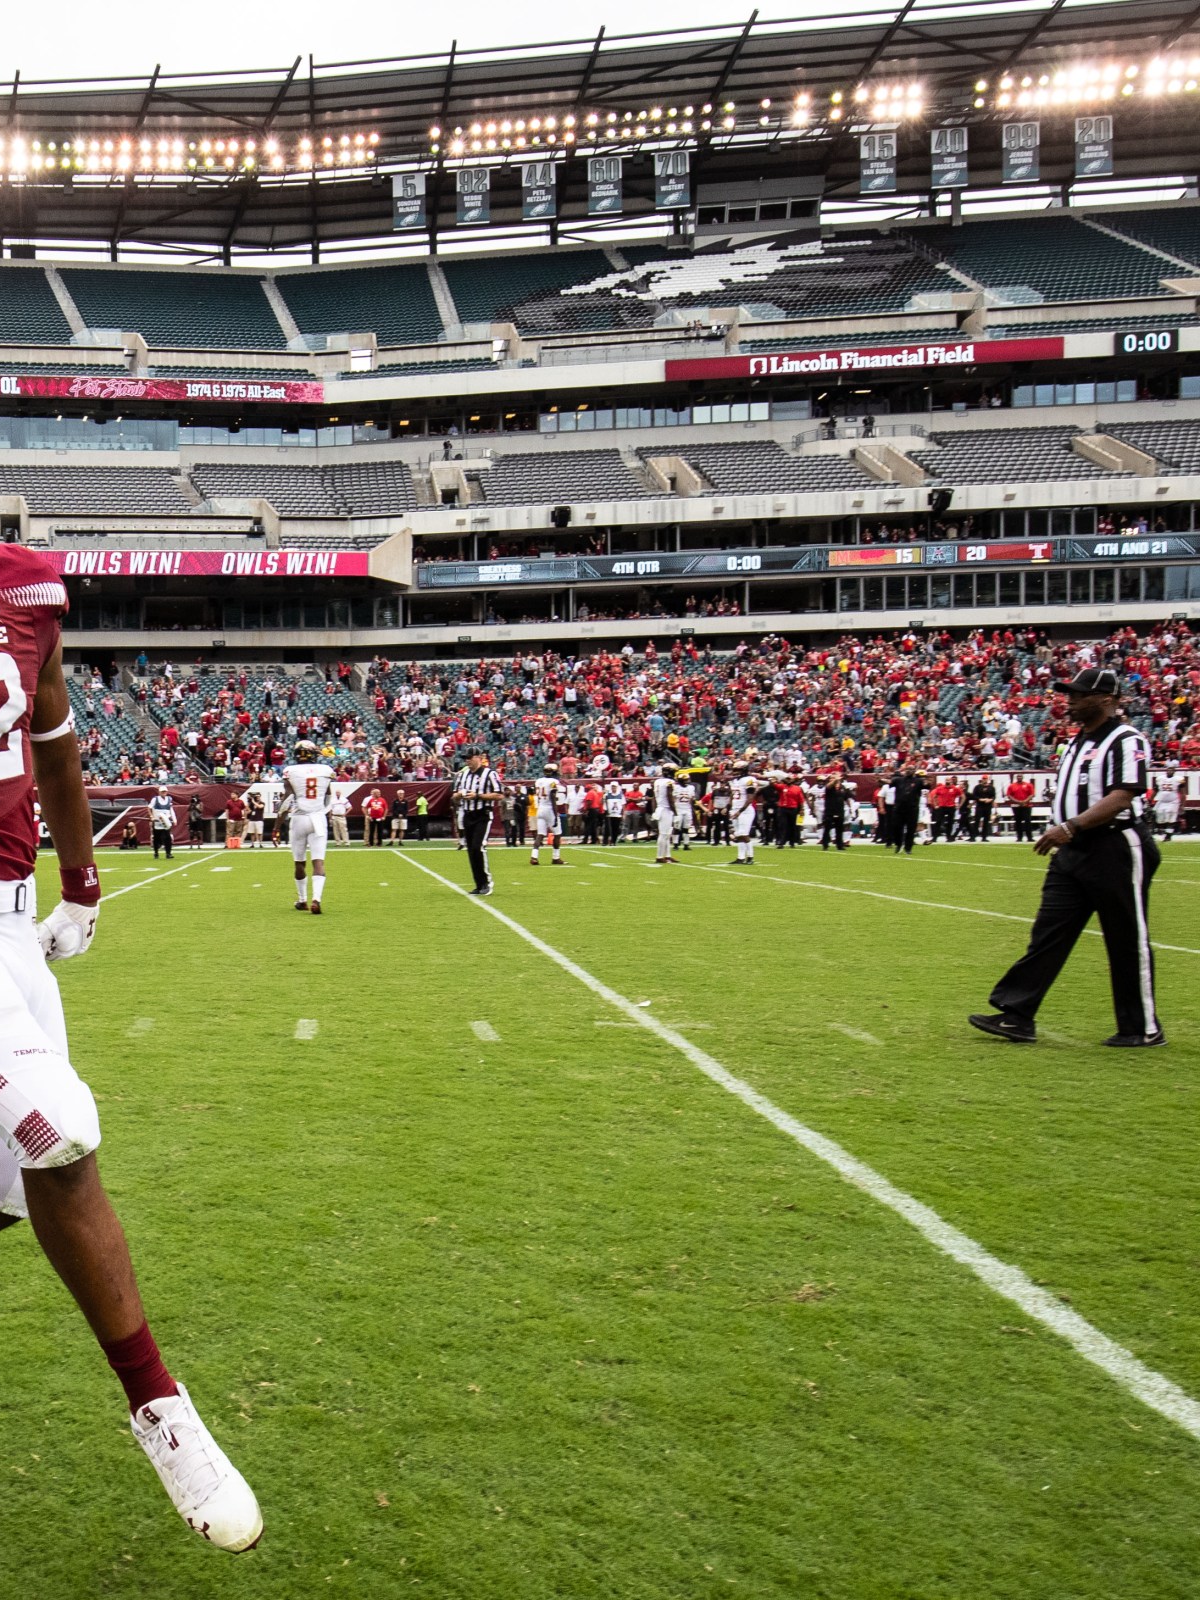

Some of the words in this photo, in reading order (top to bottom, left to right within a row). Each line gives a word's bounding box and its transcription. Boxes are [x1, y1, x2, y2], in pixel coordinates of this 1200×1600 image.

[935, 128, 964, 155] 40
[1005, 123, 1037, 150] 99
[1078, 118, 1110, 144] 20
[863, 135, 894, 160] 15
[590, 158, 619, 183] 60
[657, 152, 686, 177] 70
[402, 175, 416, 198] 5
[460, 169, 487, 194] 92
[525, 164, 552, 188] 44
[1123, 332, 1171, 352] 0:00
[770, 354, 838, 374] Lincoln
[840, 347, 925, 369] Financial
[926, 345, 975, 365] Field
[0, 377, 21, 394] OL
[186, 384, 211, 397] 1974
[221, 384, 246, 398] 1975
[895, 549, 913, 564] 15
[966, 546, 987, 561] 20
[1094, 543, 1118, 555] 4TH
[1121, 542, 1149, 555] AND
[1152, 541, 1167, 554] 21
[64, 552, 122, 574] OWLS
[129, 552, 181, 574] WIN!
[221, 553, 279, 574] OWLS
[286, 553, 337, 574] WIN!
[612, 562, 634, 574] 4TH
[637, 561, 660, 575] QTR
[727, 556, 761, 570] 0:00
[306, 778, 317, 799] 8
[13, 1048, 48, 1057] TEMPLE
